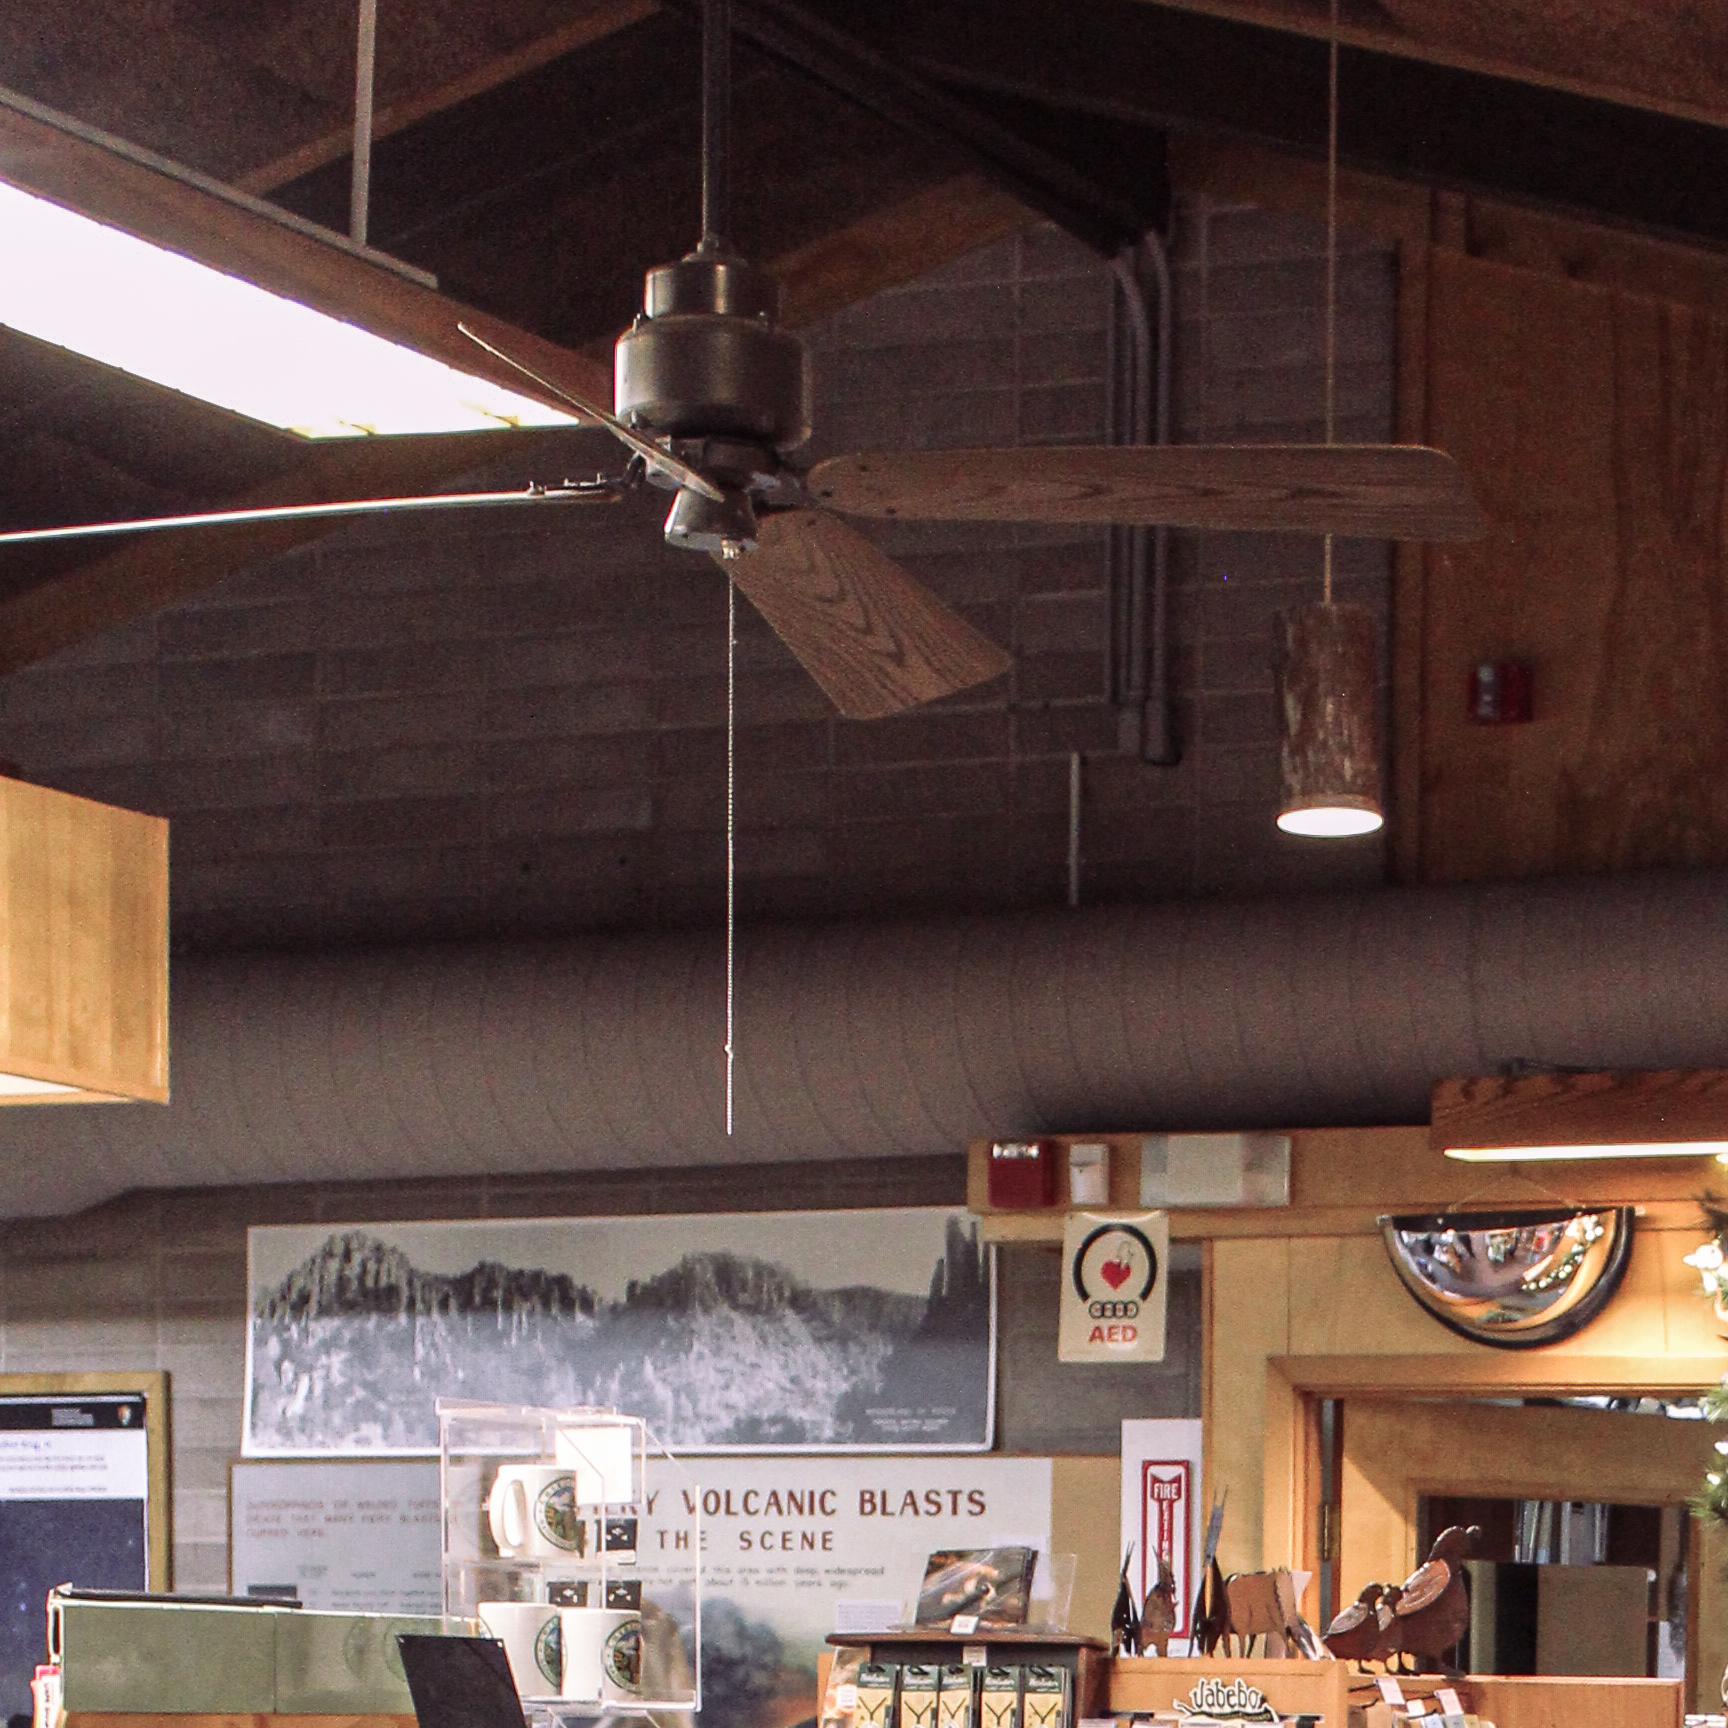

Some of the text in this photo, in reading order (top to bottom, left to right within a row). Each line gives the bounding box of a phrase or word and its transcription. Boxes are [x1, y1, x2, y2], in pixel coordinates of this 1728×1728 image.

[1088, 1325, 1137, 1343] AED
[1153, 1482, 1178, 1499] FIRE
[682, 1488, 838, 1517] VOLCANIC
[858, 1489, 987, 1517] BLASTS
[656, 1530, 834, 1552] THE SCENE
[825, 1566, 885, 1577] widespread
[1191, 1679, 1264, 1709] Jabebo
